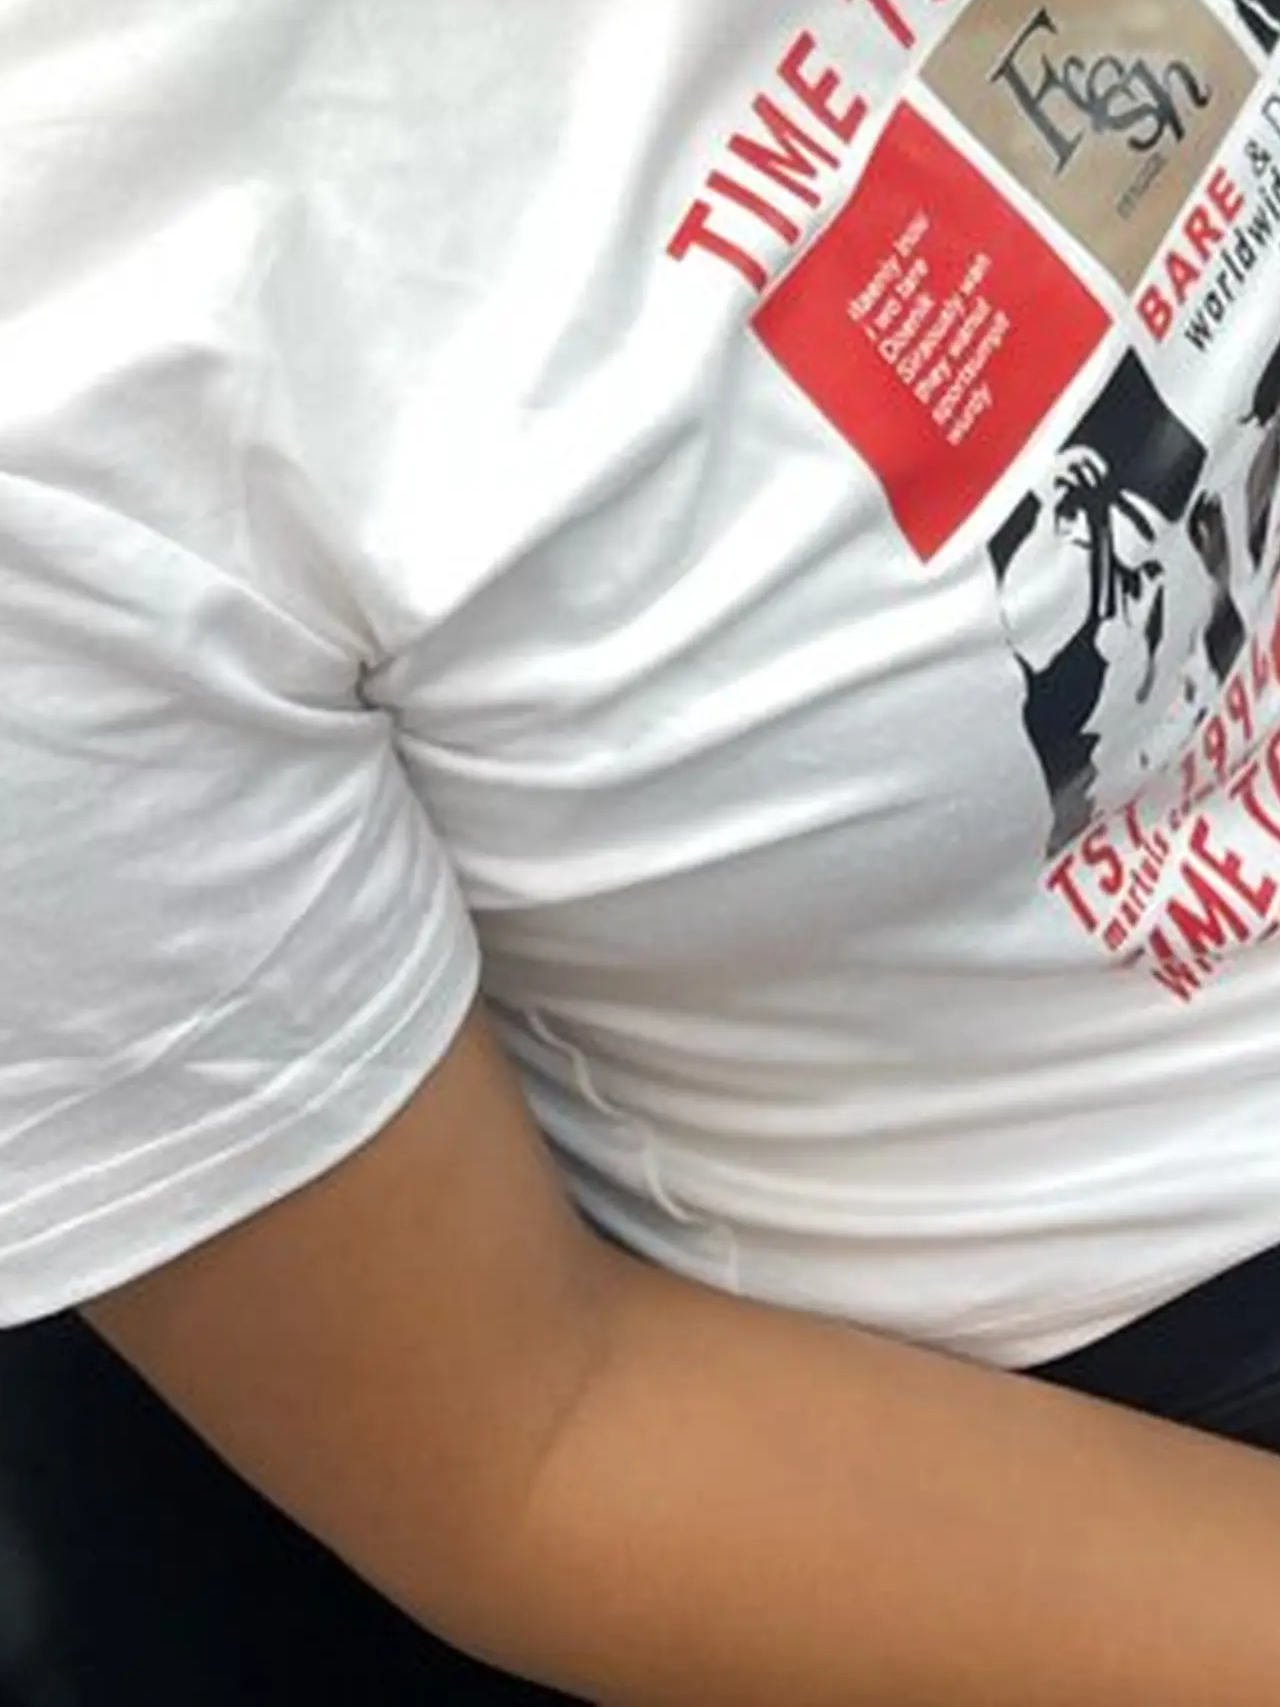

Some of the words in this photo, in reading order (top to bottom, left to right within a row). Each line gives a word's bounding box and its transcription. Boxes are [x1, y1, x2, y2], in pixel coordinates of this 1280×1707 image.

[665, 29, 868, 293] TIME
[1133, 167, 1247, 343] BARE
[1249, 140, 1275, 174] &
